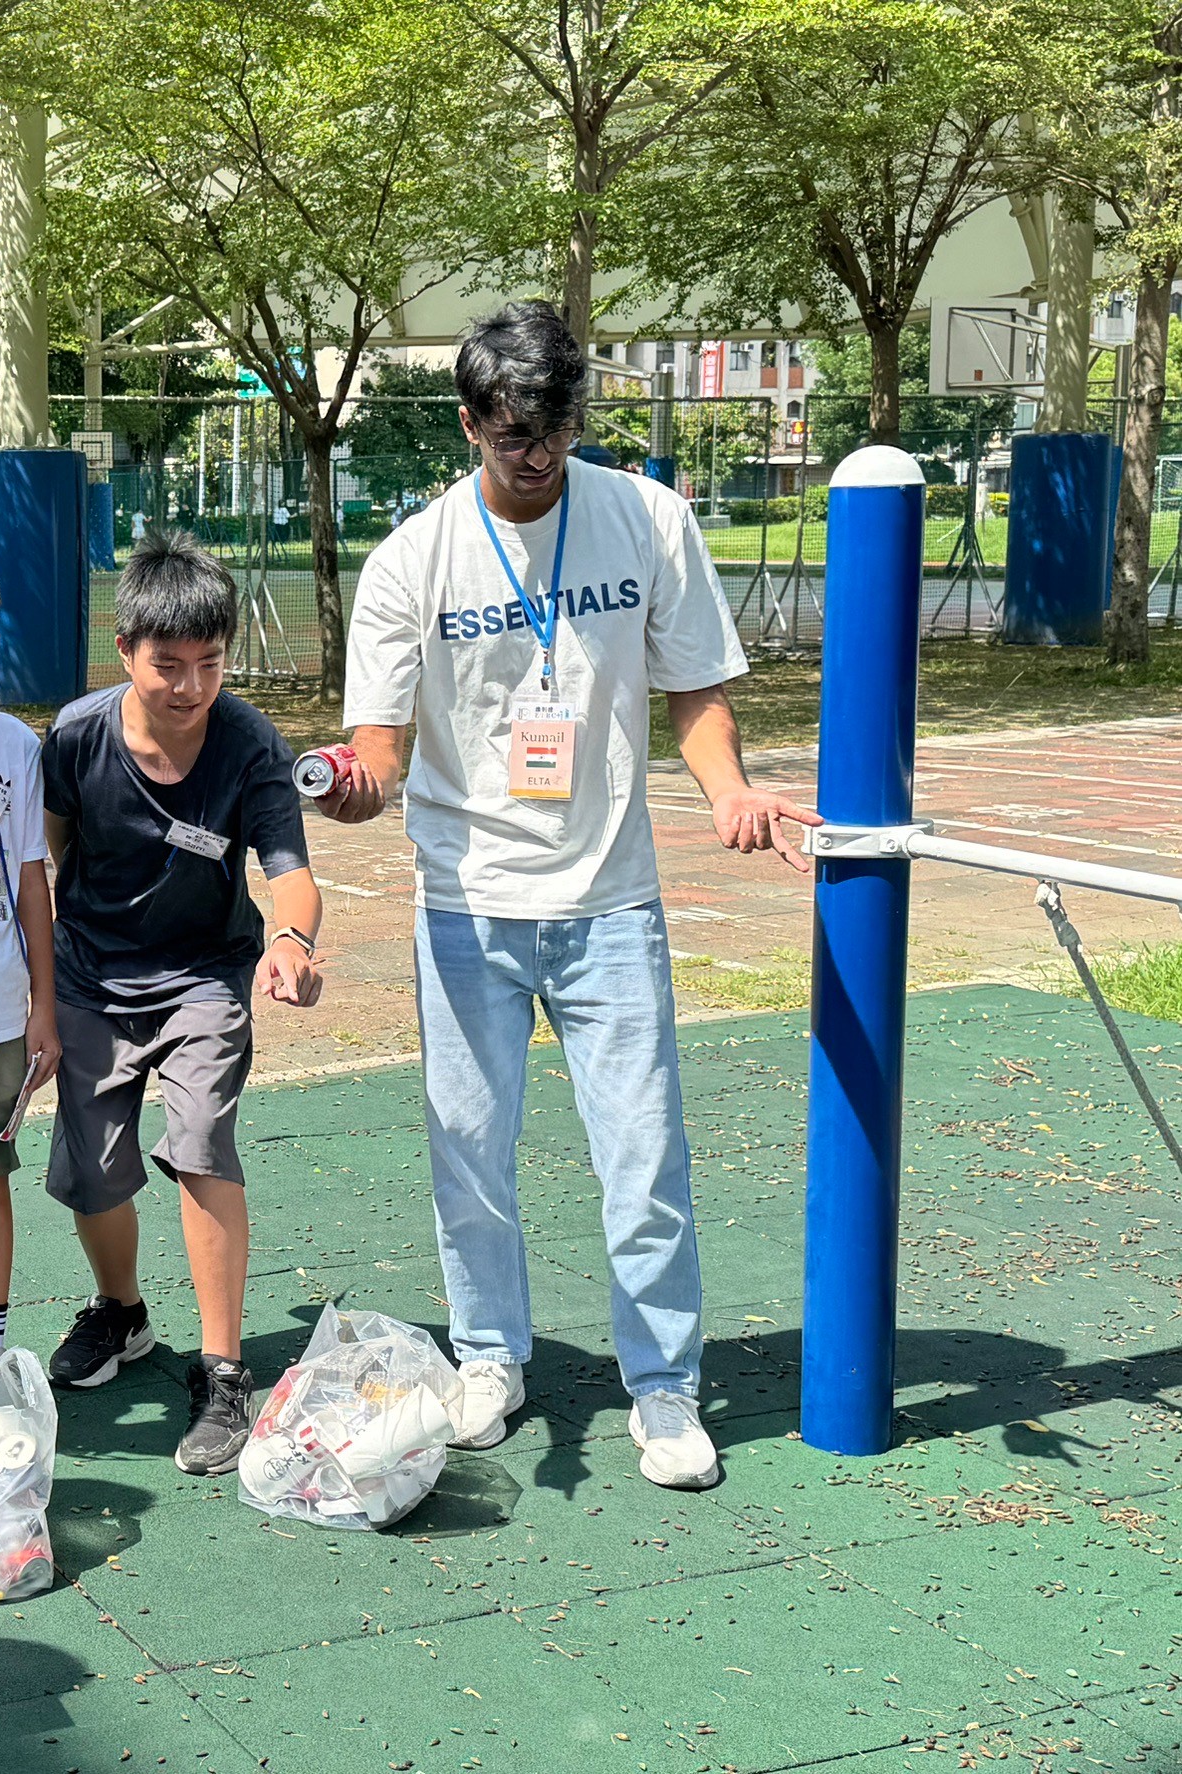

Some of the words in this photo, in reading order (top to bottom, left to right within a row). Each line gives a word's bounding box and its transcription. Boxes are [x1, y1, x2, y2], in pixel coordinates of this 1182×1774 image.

[439, 579, 641, 640] ESSENTIALS
[521, 731, 565, 743] Kumail
[527, 776, 551, 786] ELTA
